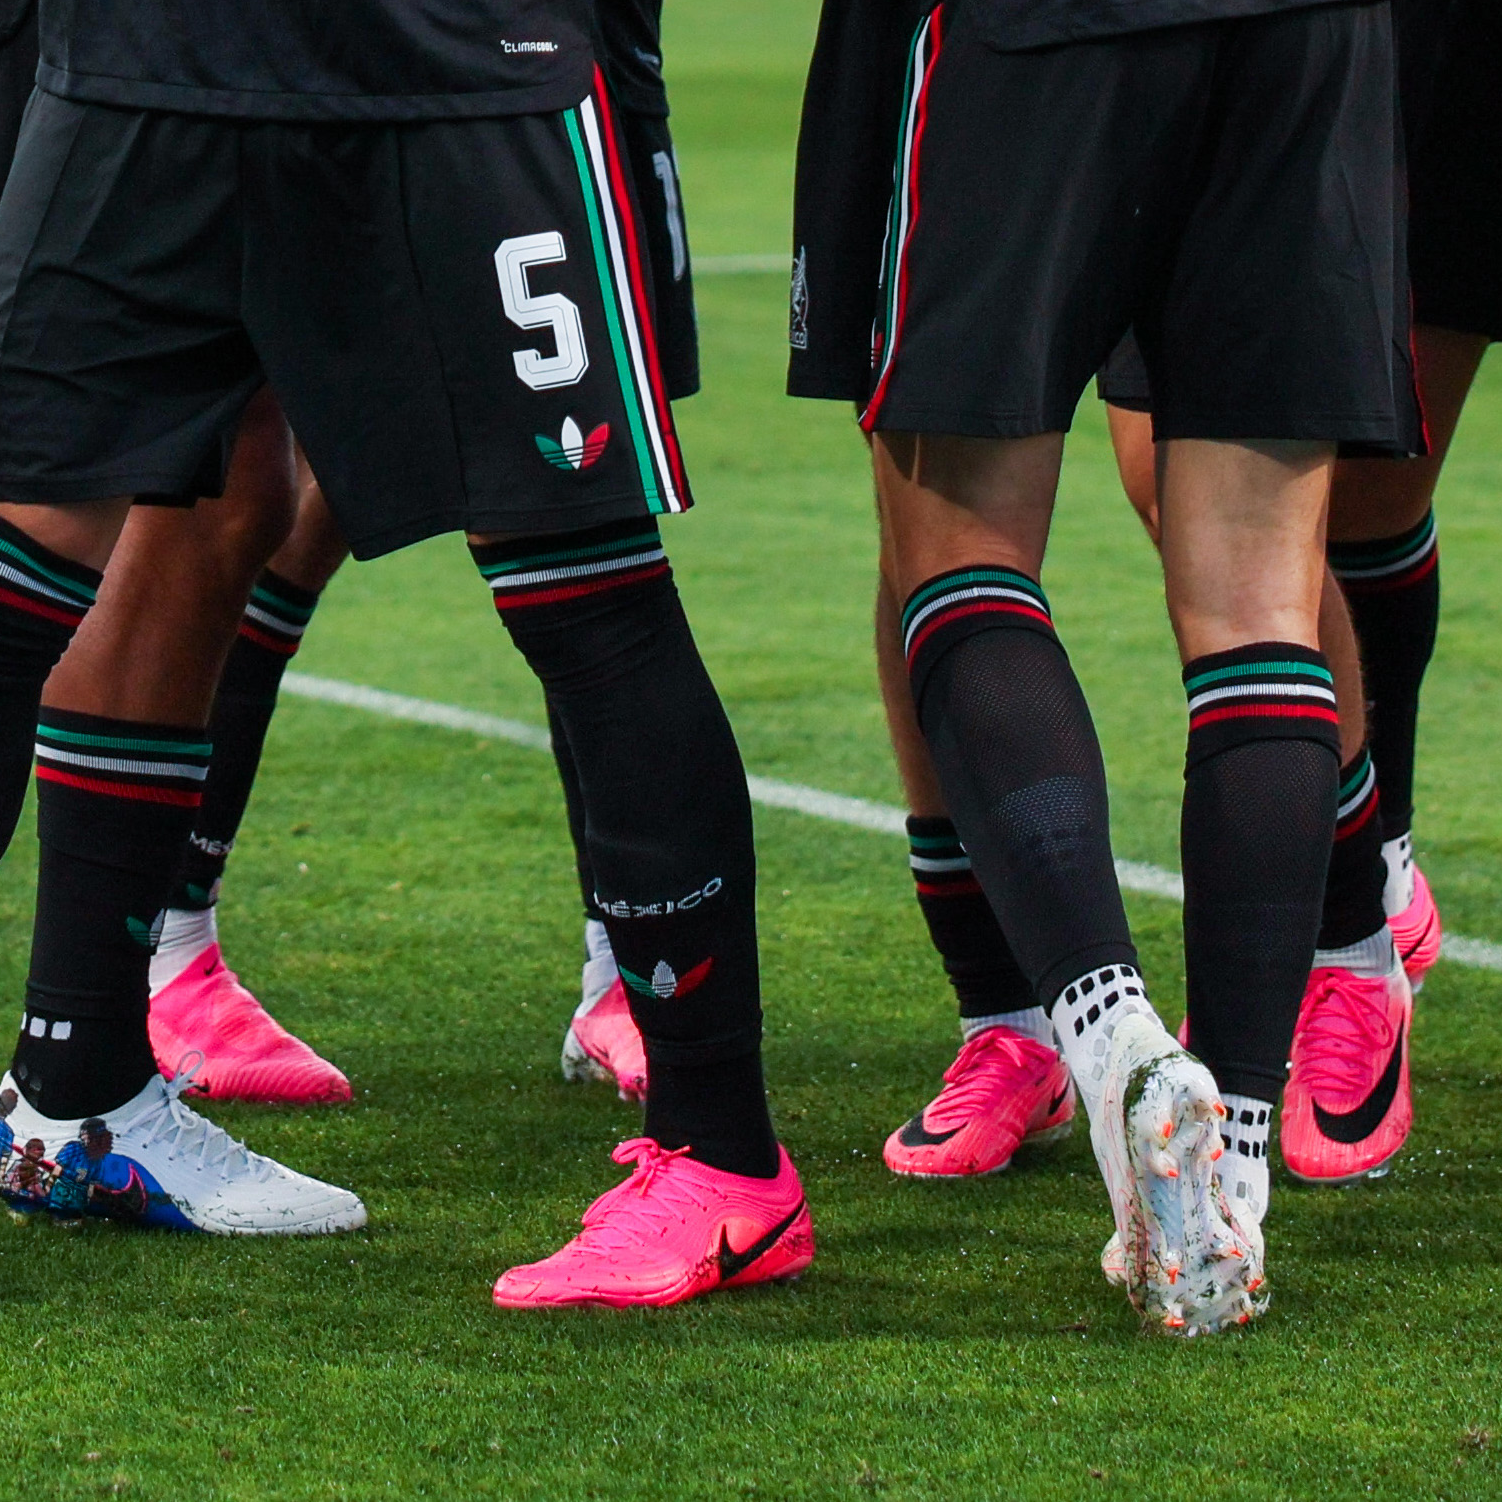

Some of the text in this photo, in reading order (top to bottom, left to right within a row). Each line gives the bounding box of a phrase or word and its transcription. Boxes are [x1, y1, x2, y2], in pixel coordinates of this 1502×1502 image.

[652, 150, 685, 283] 1
[493, 231, 589, 392] 5
[593, 877, 723, 918] MÉXICO
